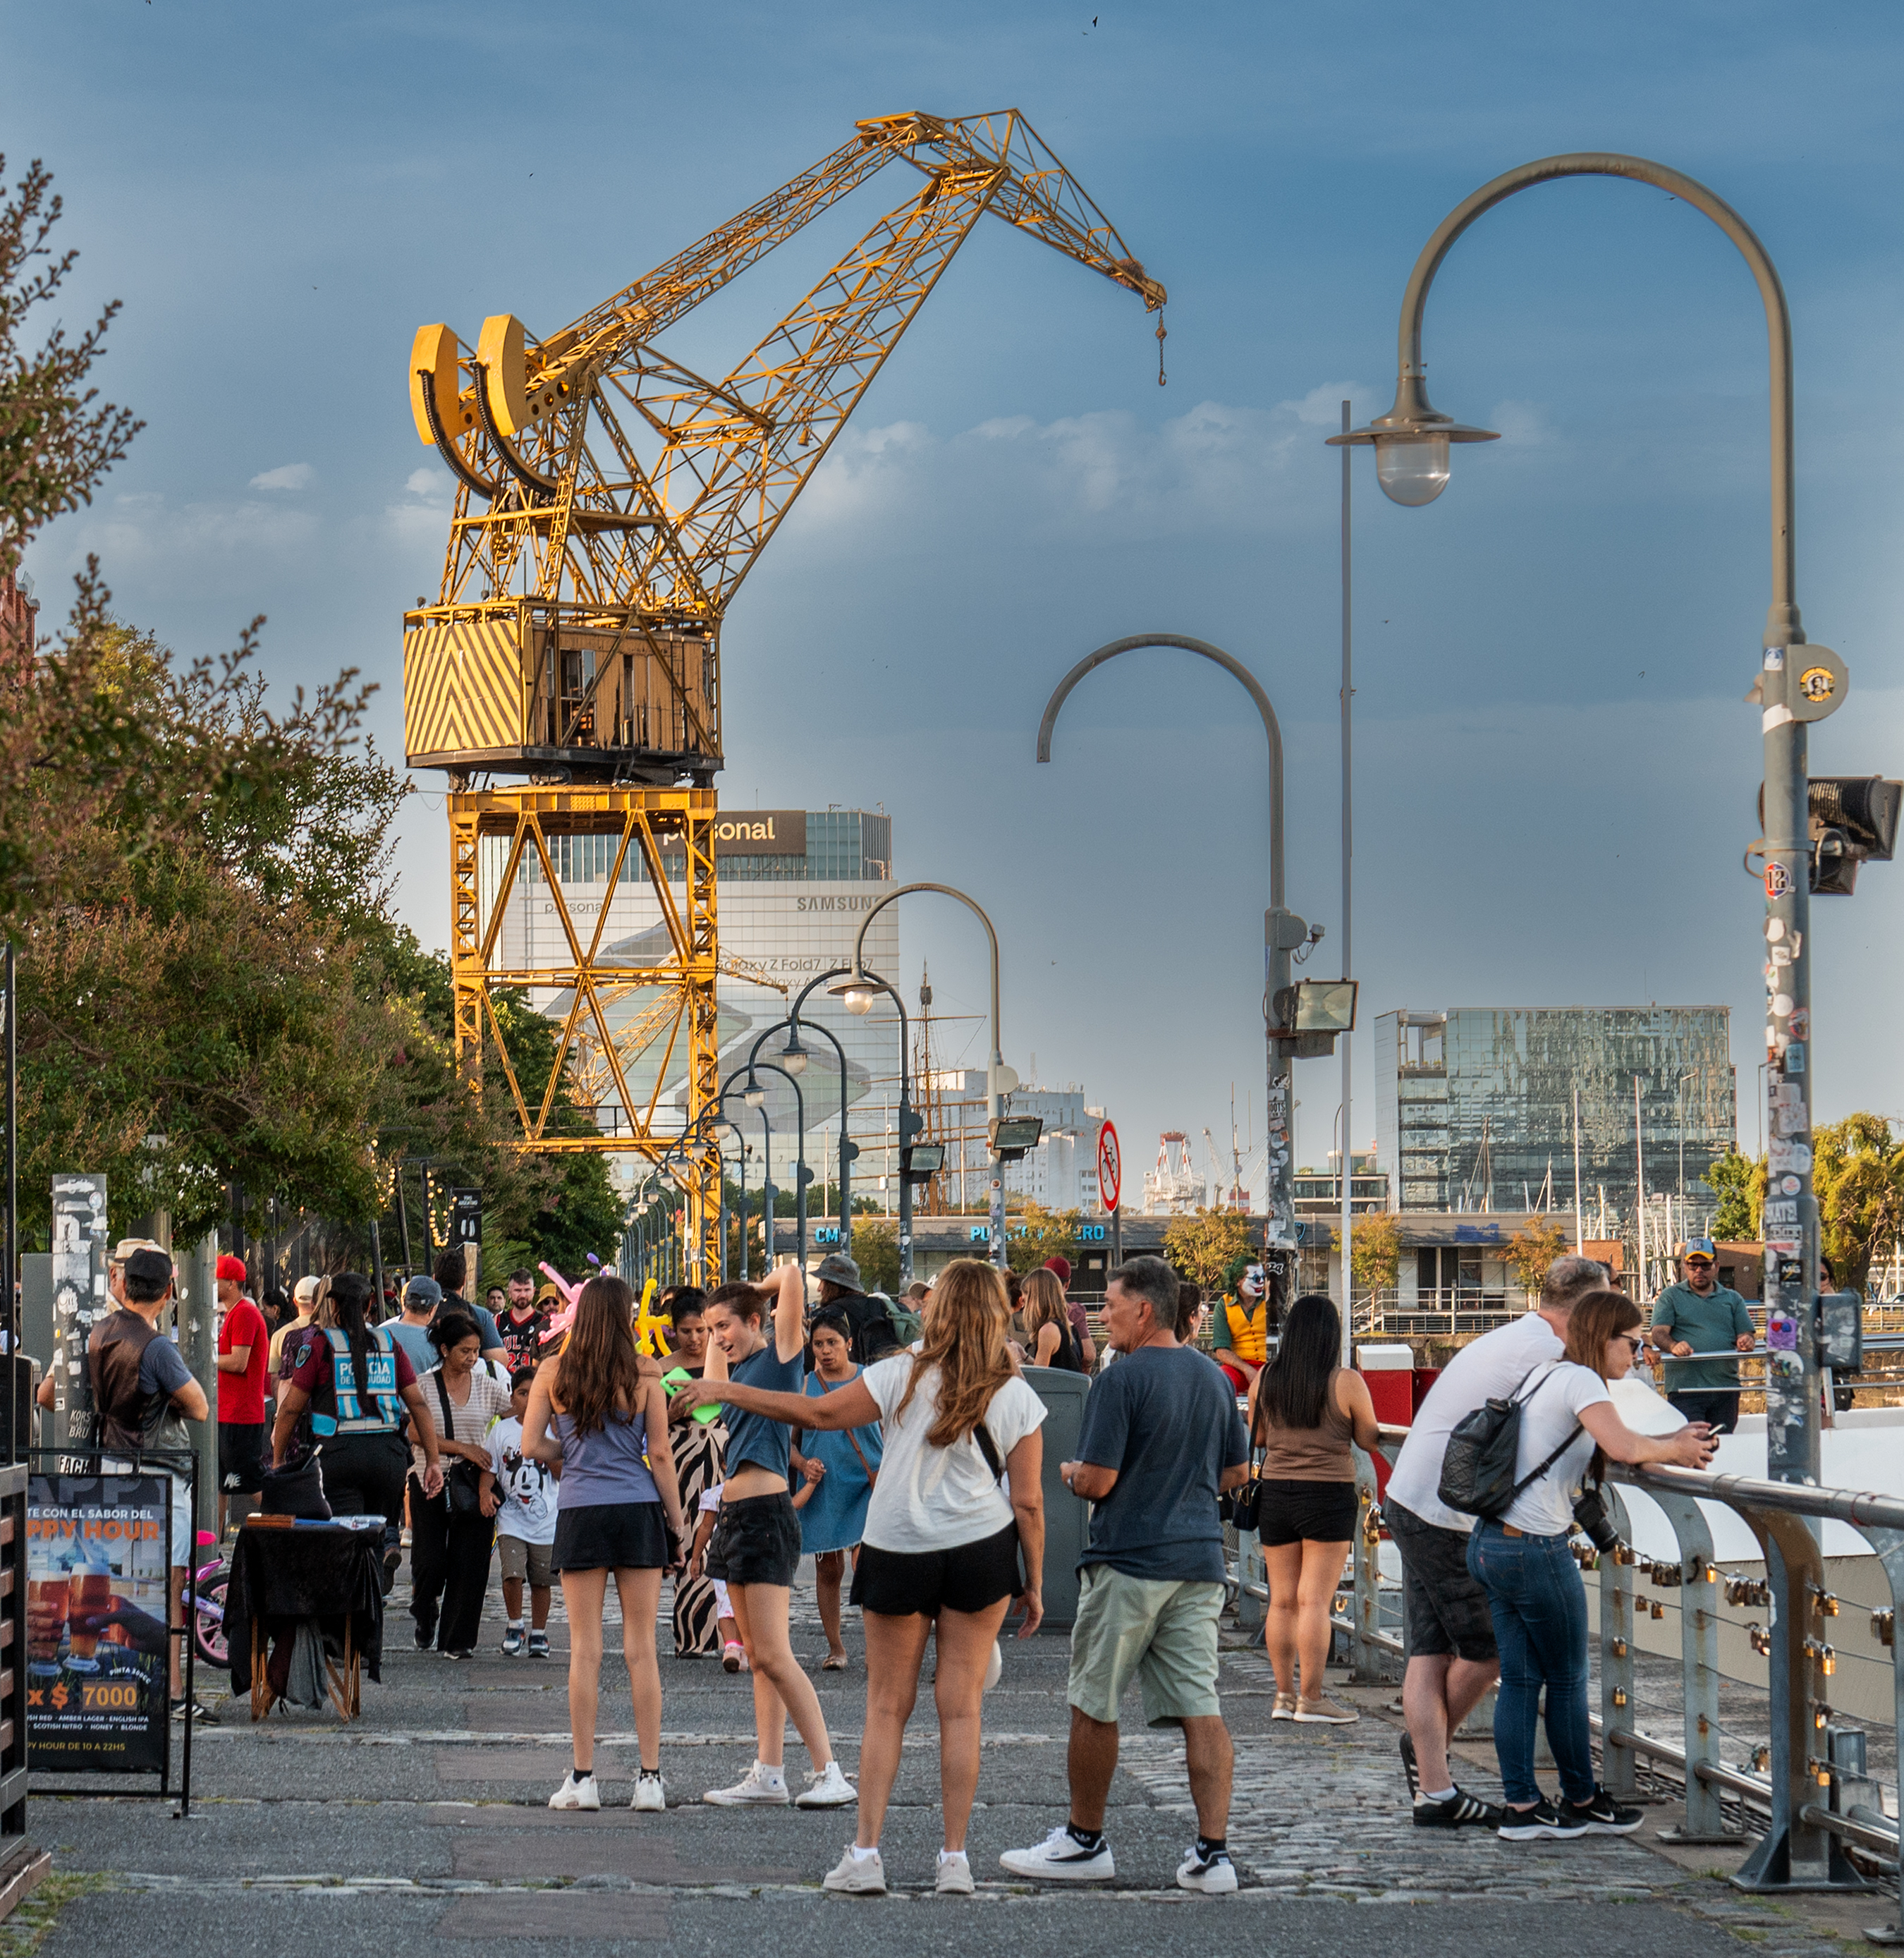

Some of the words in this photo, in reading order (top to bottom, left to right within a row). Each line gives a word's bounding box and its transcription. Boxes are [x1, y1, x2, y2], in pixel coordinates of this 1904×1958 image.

[797, 896, 881, 911] SAMSUN
[781, 959, 821, 971] Fold7
[339, 1361, 390, 1376] POCIA
[340, 1376, 350, 1385] DE
[42, 1508, 68, 1519] CON
[71, 1509, 85, 1519] EL
[87, 1509, 128, 1519] SABOR
[131, 1509, 153, 1519] DEL
[84, 1520, 159, 1540] HOUR
[83, 1686, 137, 1706] 7000
